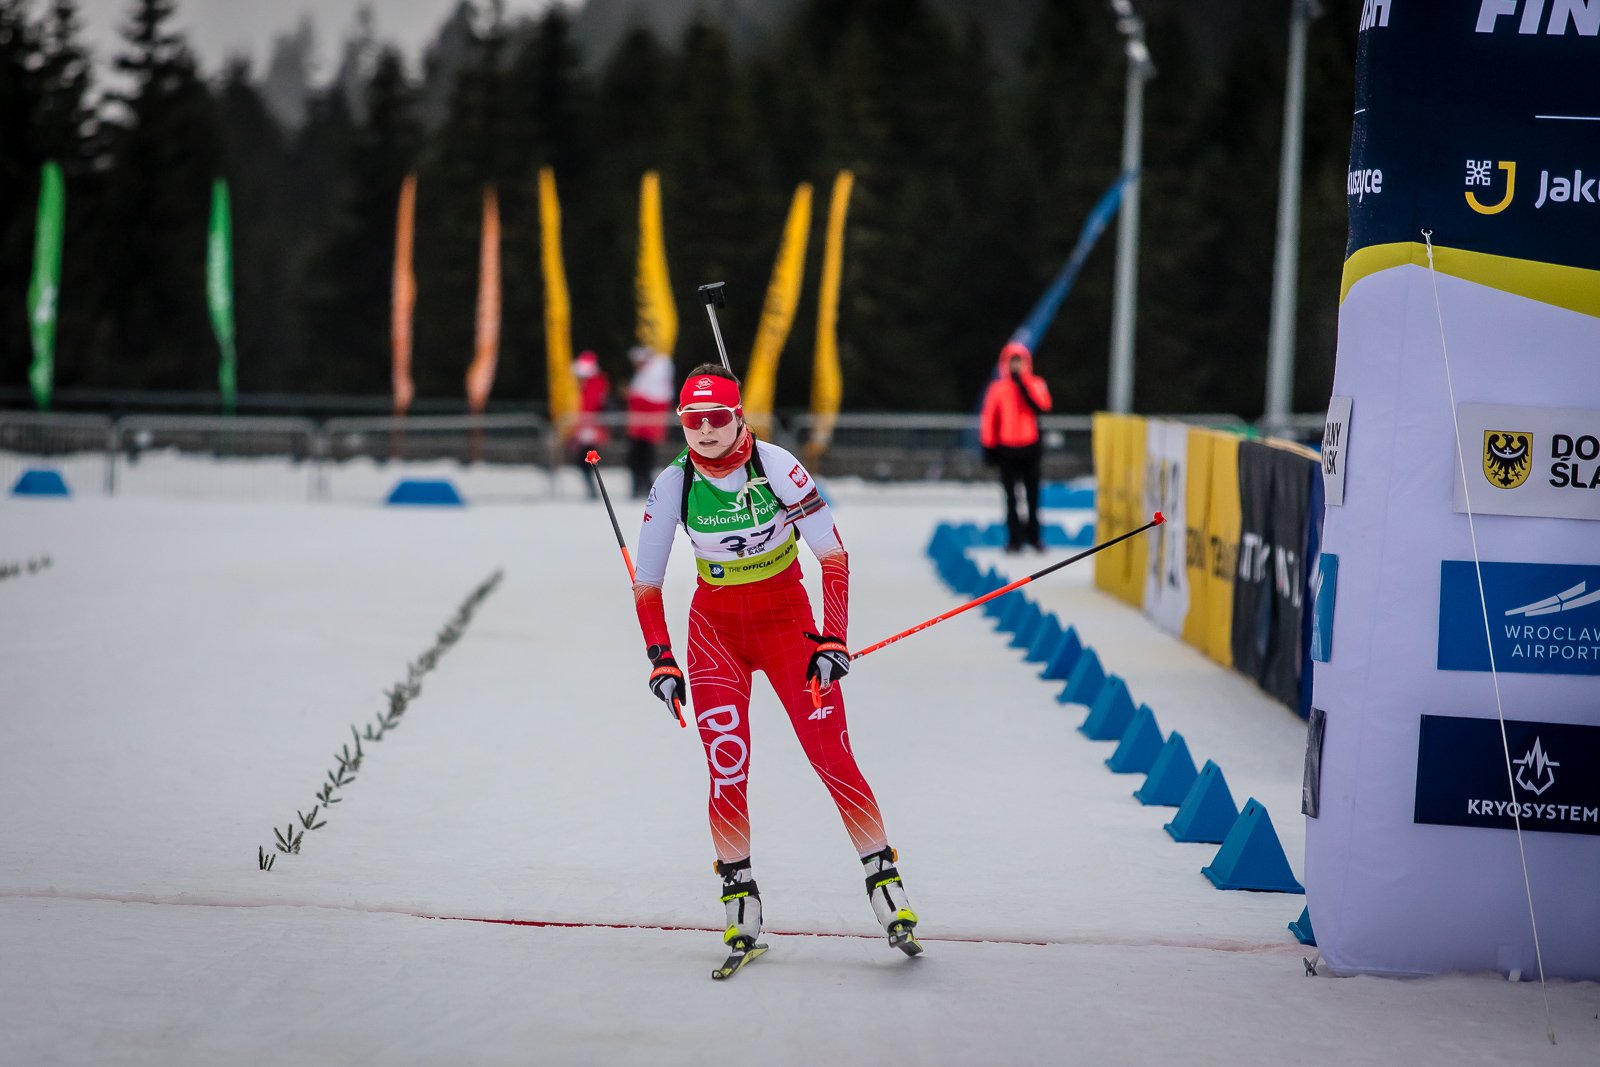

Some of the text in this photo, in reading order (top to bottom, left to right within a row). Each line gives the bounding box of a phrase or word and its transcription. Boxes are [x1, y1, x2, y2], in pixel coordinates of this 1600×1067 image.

[1475, 0, 1600, 36] FIN
[1535, 170, 1600, 208] Jak
[697, 513, 750, 526] Szklarska
[720, 524, 776, 551] 37
[743, 560, 774, 571] OFFICIAL
[1511, 643, 1600, 661] AIRPORT
[698, 704, 747, 799] POL
[1467, 799, 1599, 823] KRYOSYSTEM
